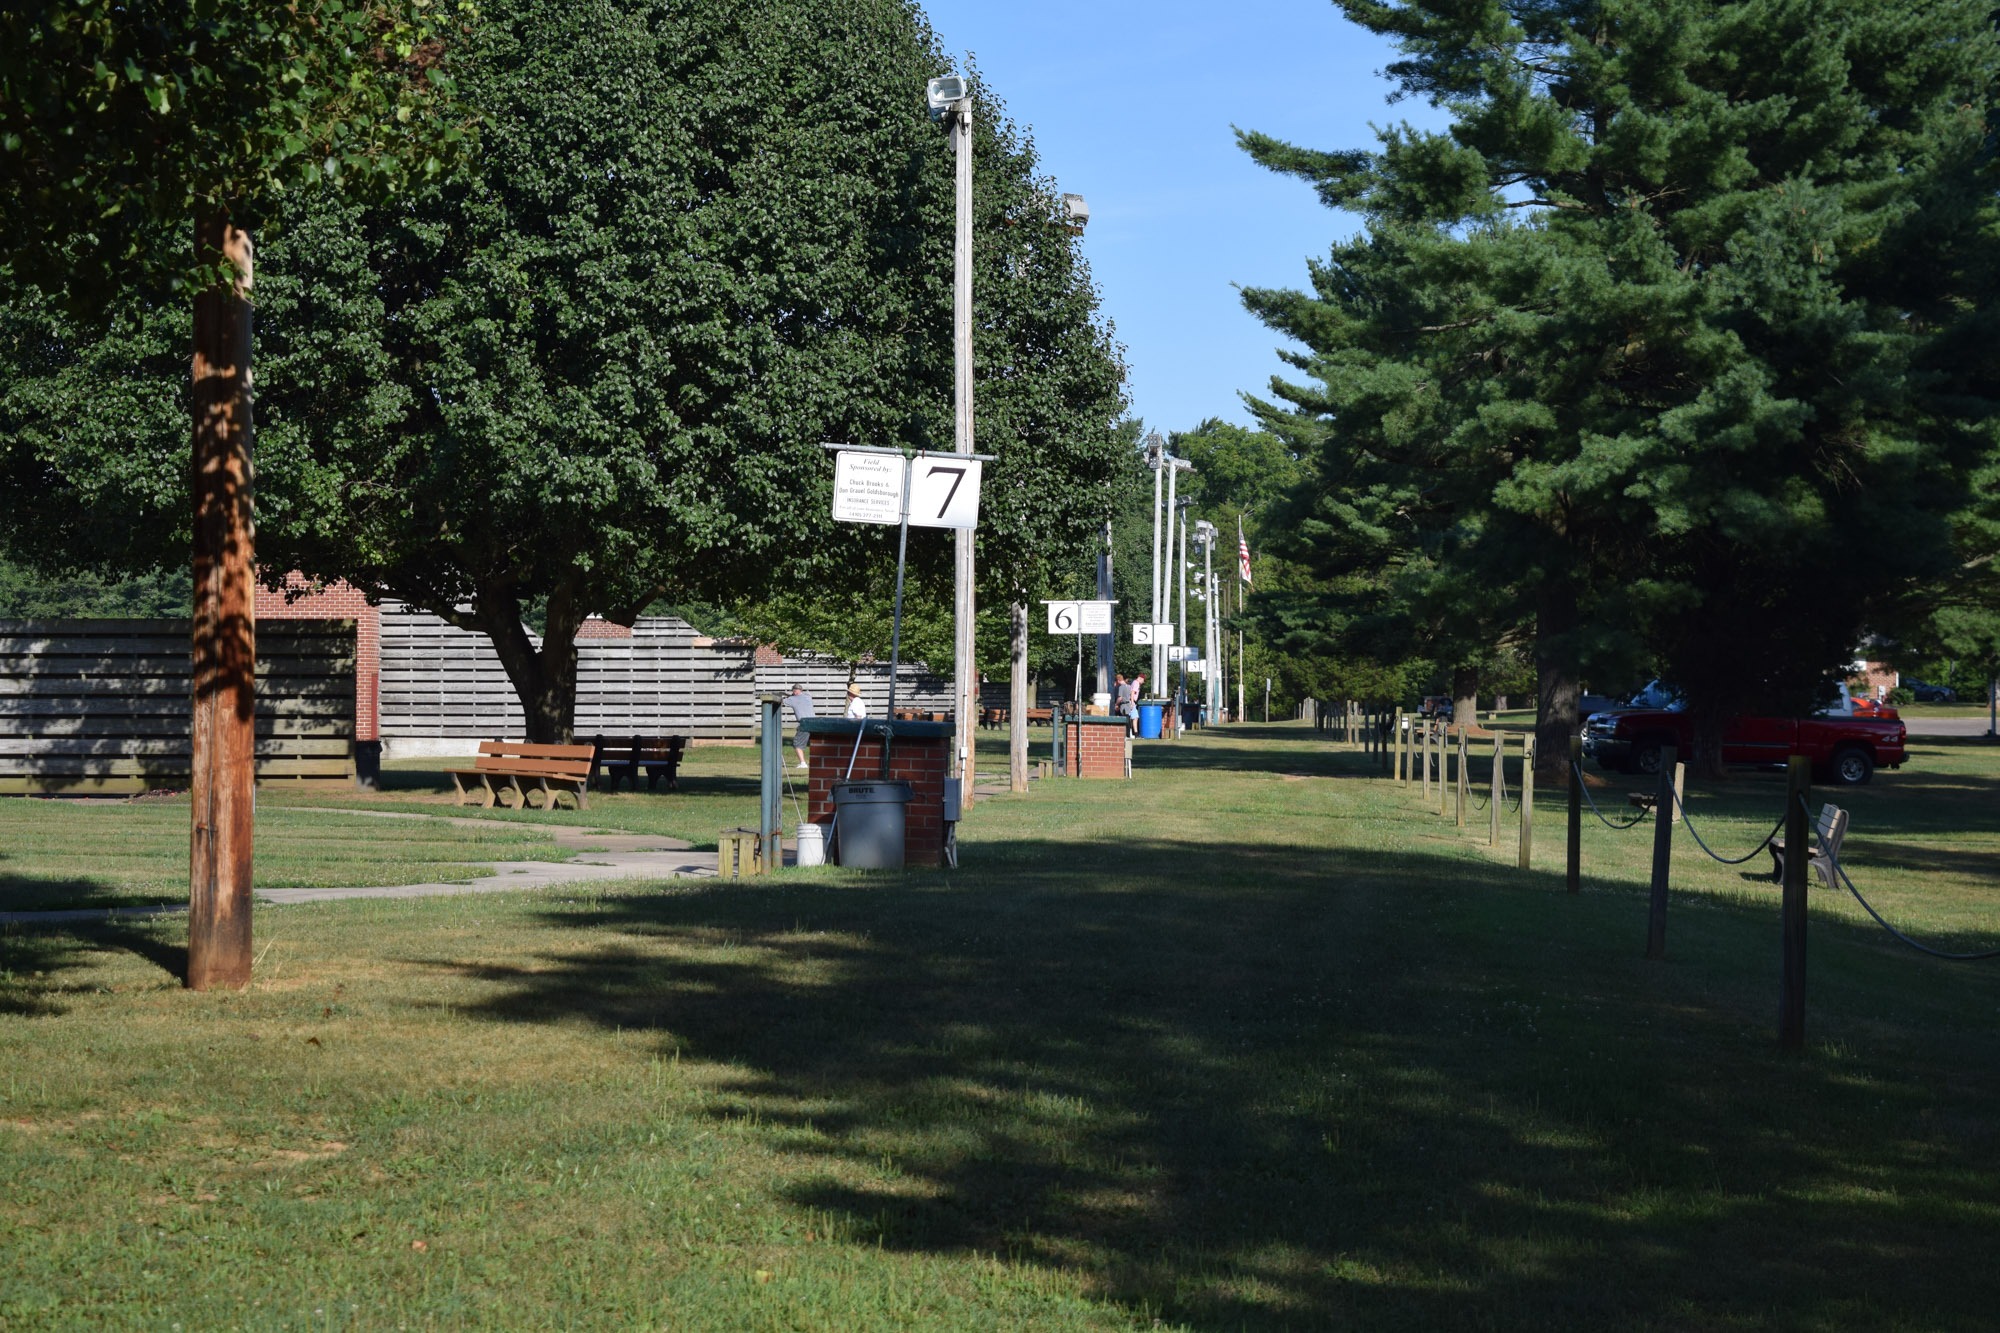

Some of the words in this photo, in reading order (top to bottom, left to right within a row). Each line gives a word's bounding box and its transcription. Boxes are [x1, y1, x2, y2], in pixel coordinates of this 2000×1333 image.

[849, 464, 882, 472] Sponsored
[926, 466, 967, 519] 7
[1055, 606, 1072, 630] 6
[1137, 626, 1148, 642] 5
[1171, 649, 1181, 660] 4
[1189, 661, 1197, 671] 3
